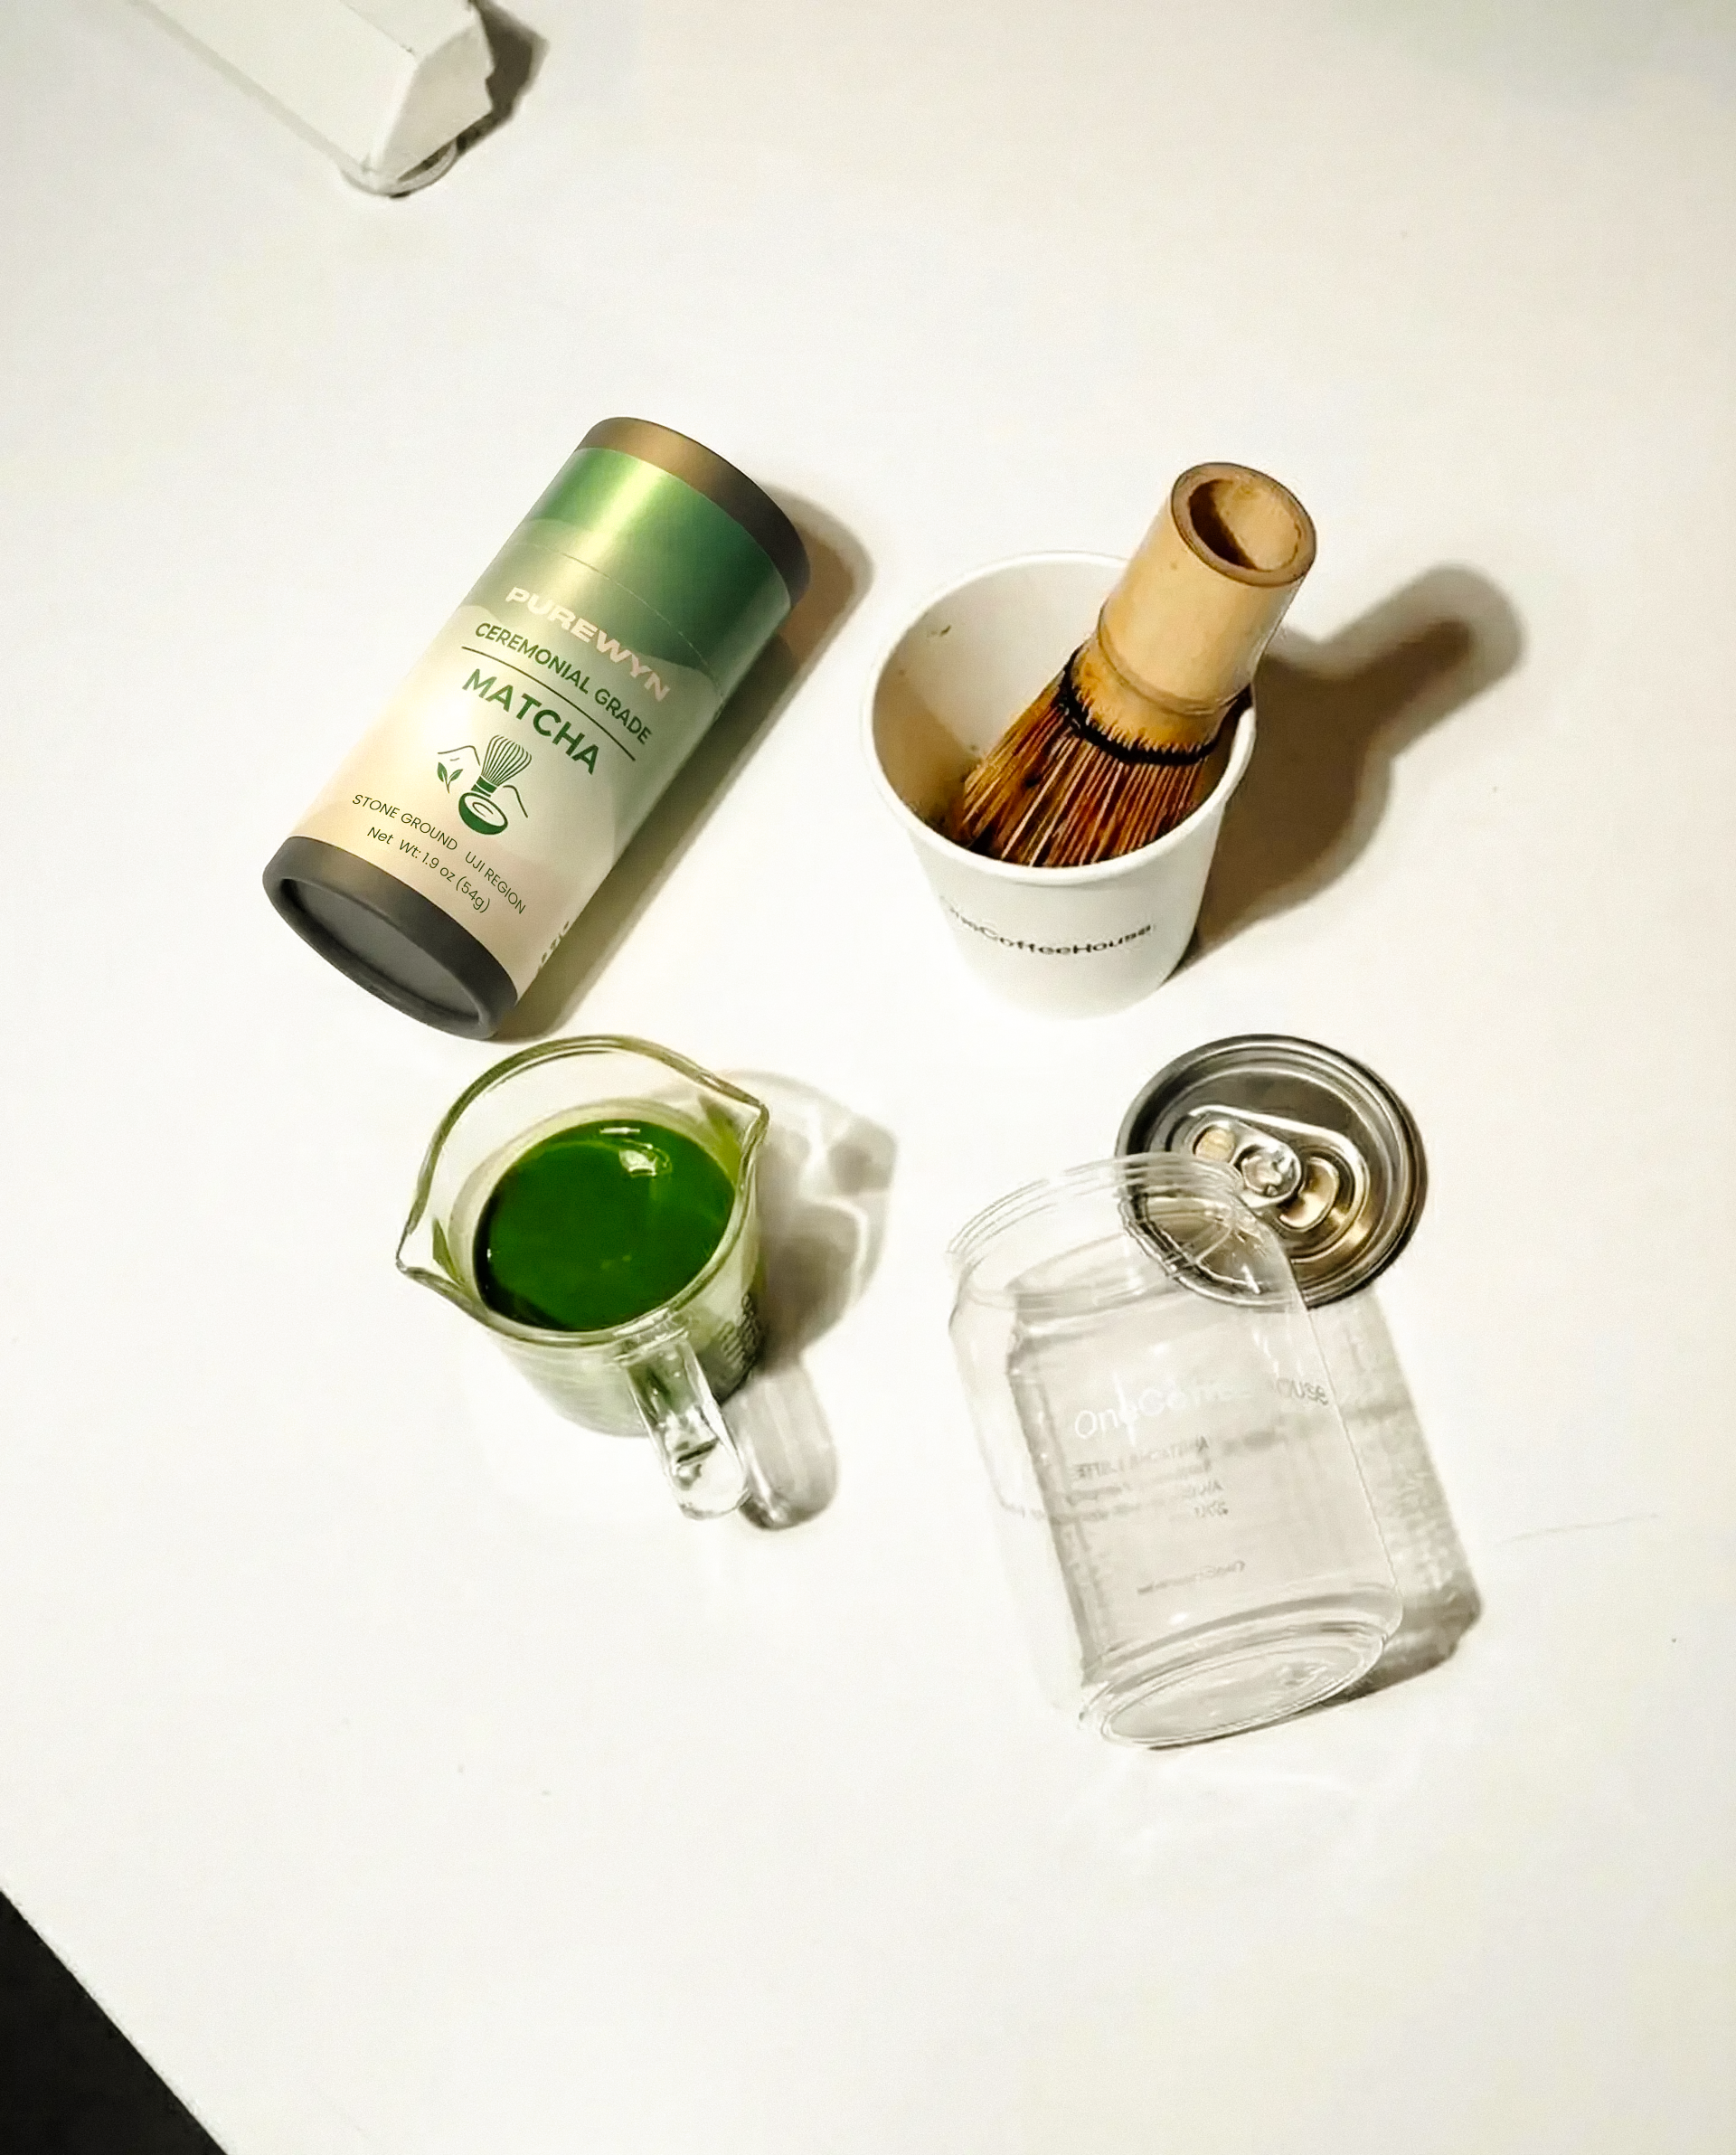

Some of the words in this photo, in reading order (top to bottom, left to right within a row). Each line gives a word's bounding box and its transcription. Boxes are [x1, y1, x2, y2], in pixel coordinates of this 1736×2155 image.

[475, 622, 590, 695] CEREMONIAL
[594, 688, 652, 745] GRADE
[505, 587, 671, 702] PUREWYN
[462, 668, 600, 775] MATCHA
[352, 794, 401, 818] STONE
[401, 812, 458, 851] GROUND
[465, 851, 486, 873] UJI
[484, 867, 526, 914] REGION
[367, 827, 394, 845] Net
[399, 839, 421, 860] Wt:
[421, 852, 439, 869] 1.9
[439, 865, 456, 883] oz
[456, 876, 491, 913] (54g)
